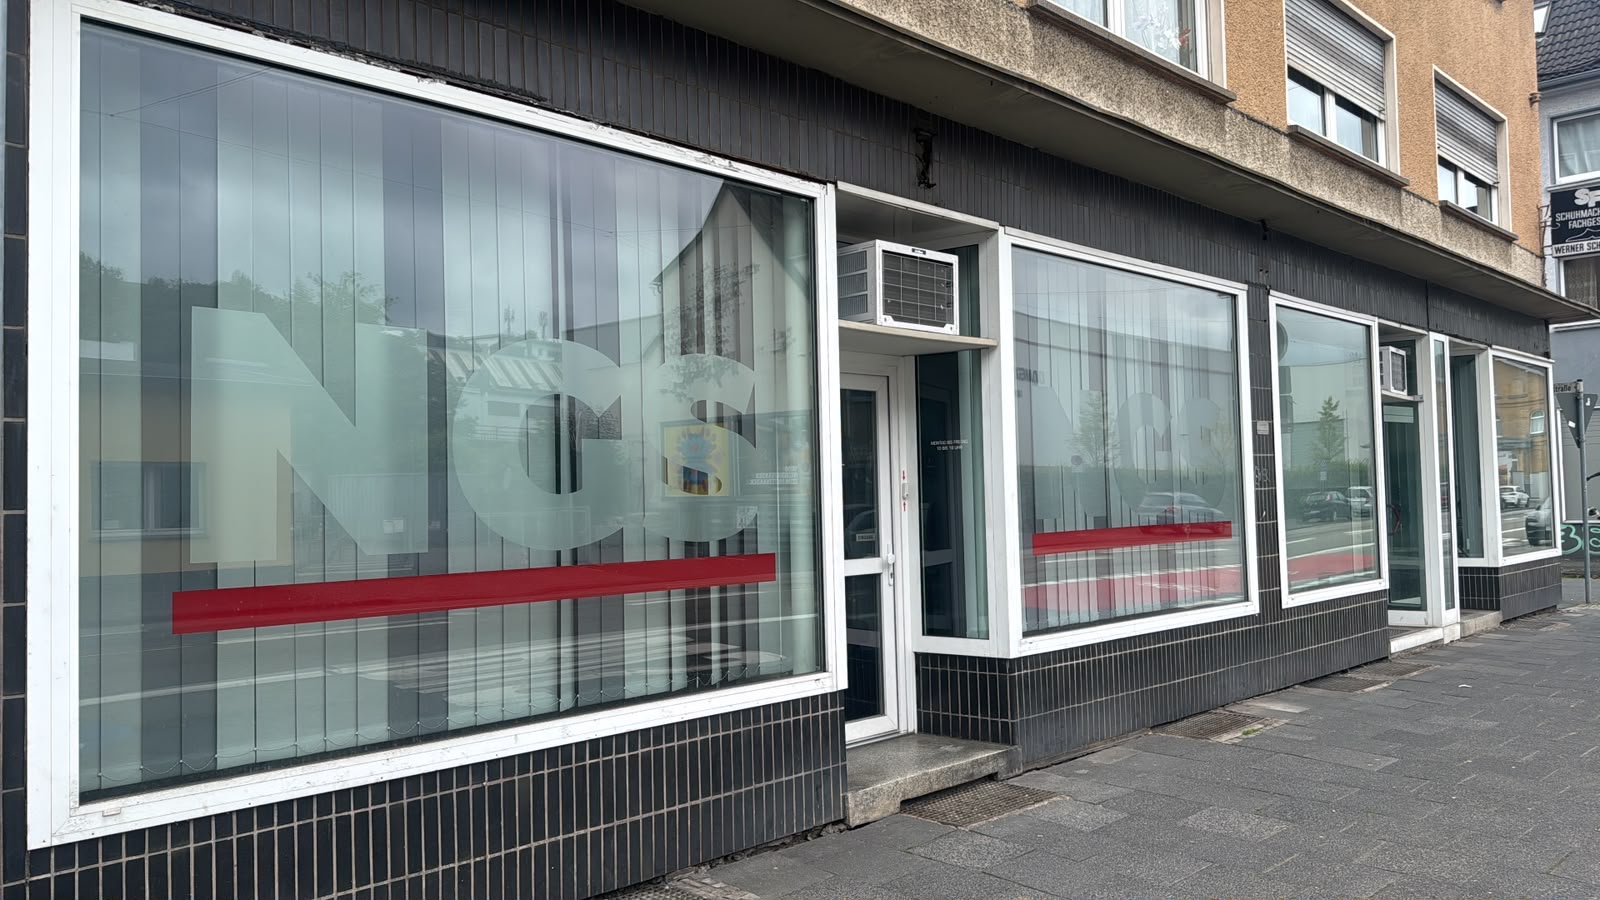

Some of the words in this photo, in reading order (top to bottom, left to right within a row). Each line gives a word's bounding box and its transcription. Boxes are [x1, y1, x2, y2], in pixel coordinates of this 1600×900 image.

[1554, 244, 1584, 255] WERNER
[1553, 384, 1571, 392] traße
[190, 306, 757, 564] NGS
